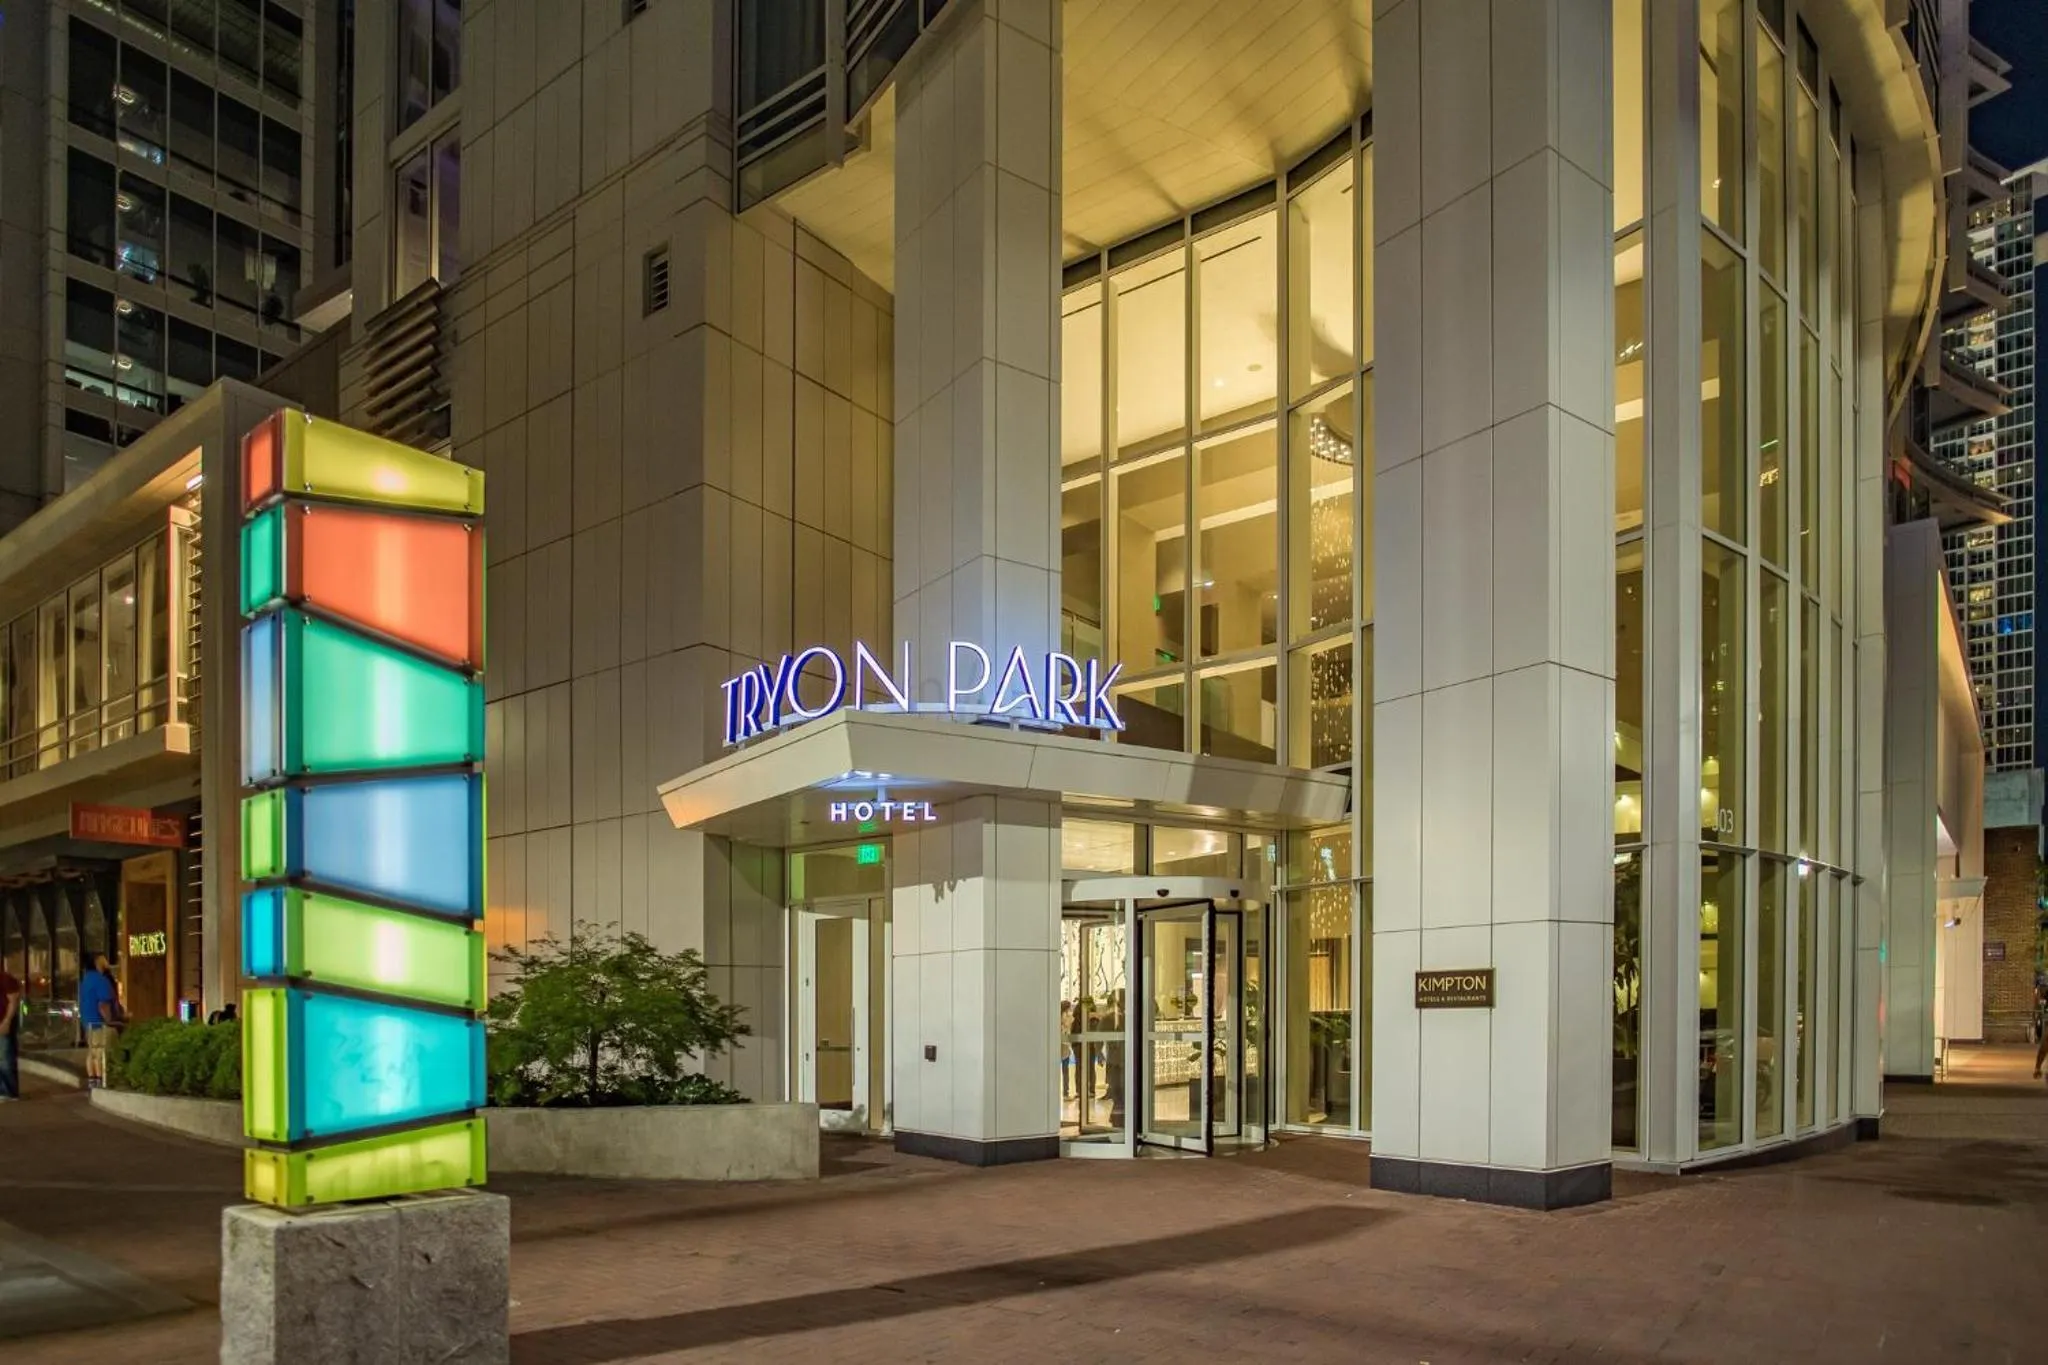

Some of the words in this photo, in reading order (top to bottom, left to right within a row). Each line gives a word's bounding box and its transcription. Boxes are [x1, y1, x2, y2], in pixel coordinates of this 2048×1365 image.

[720, 640, 909, 743] TRYON
[948, 640, 1125, 729] PARK
[830, 802, 937, 822] HOTEL
[1418, 975, 1487, 992] KIMPTON
